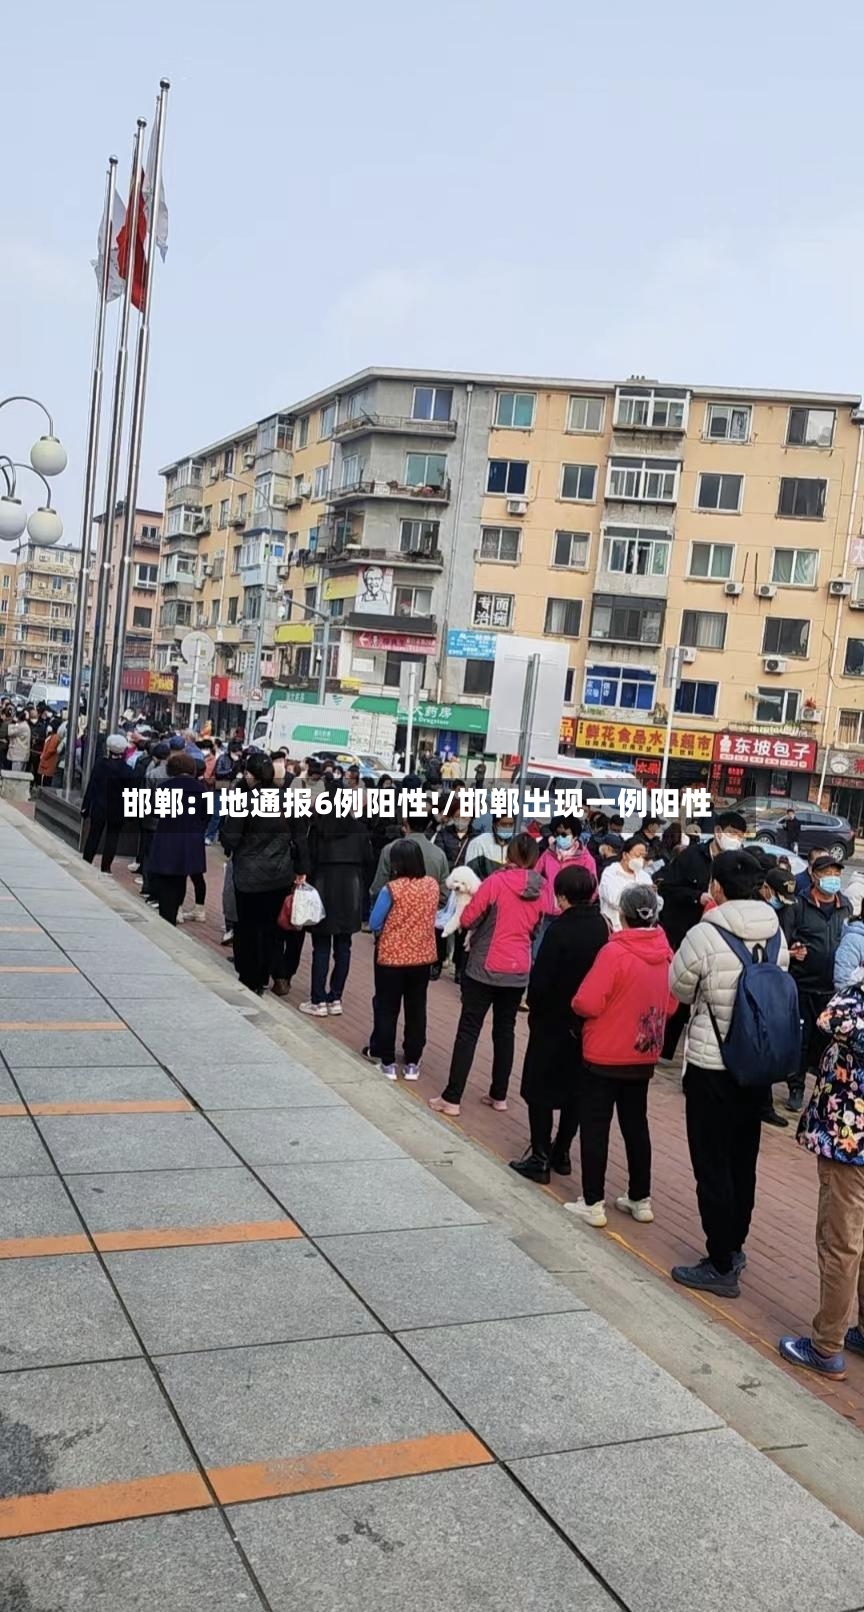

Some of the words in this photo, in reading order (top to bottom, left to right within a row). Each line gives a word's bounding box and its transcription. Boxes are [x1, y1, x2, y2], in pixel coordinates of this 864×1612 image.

[585, 723, 712, 751] 鲜花食品水果超市
[734, 737, 811, 760] 东坡包子
